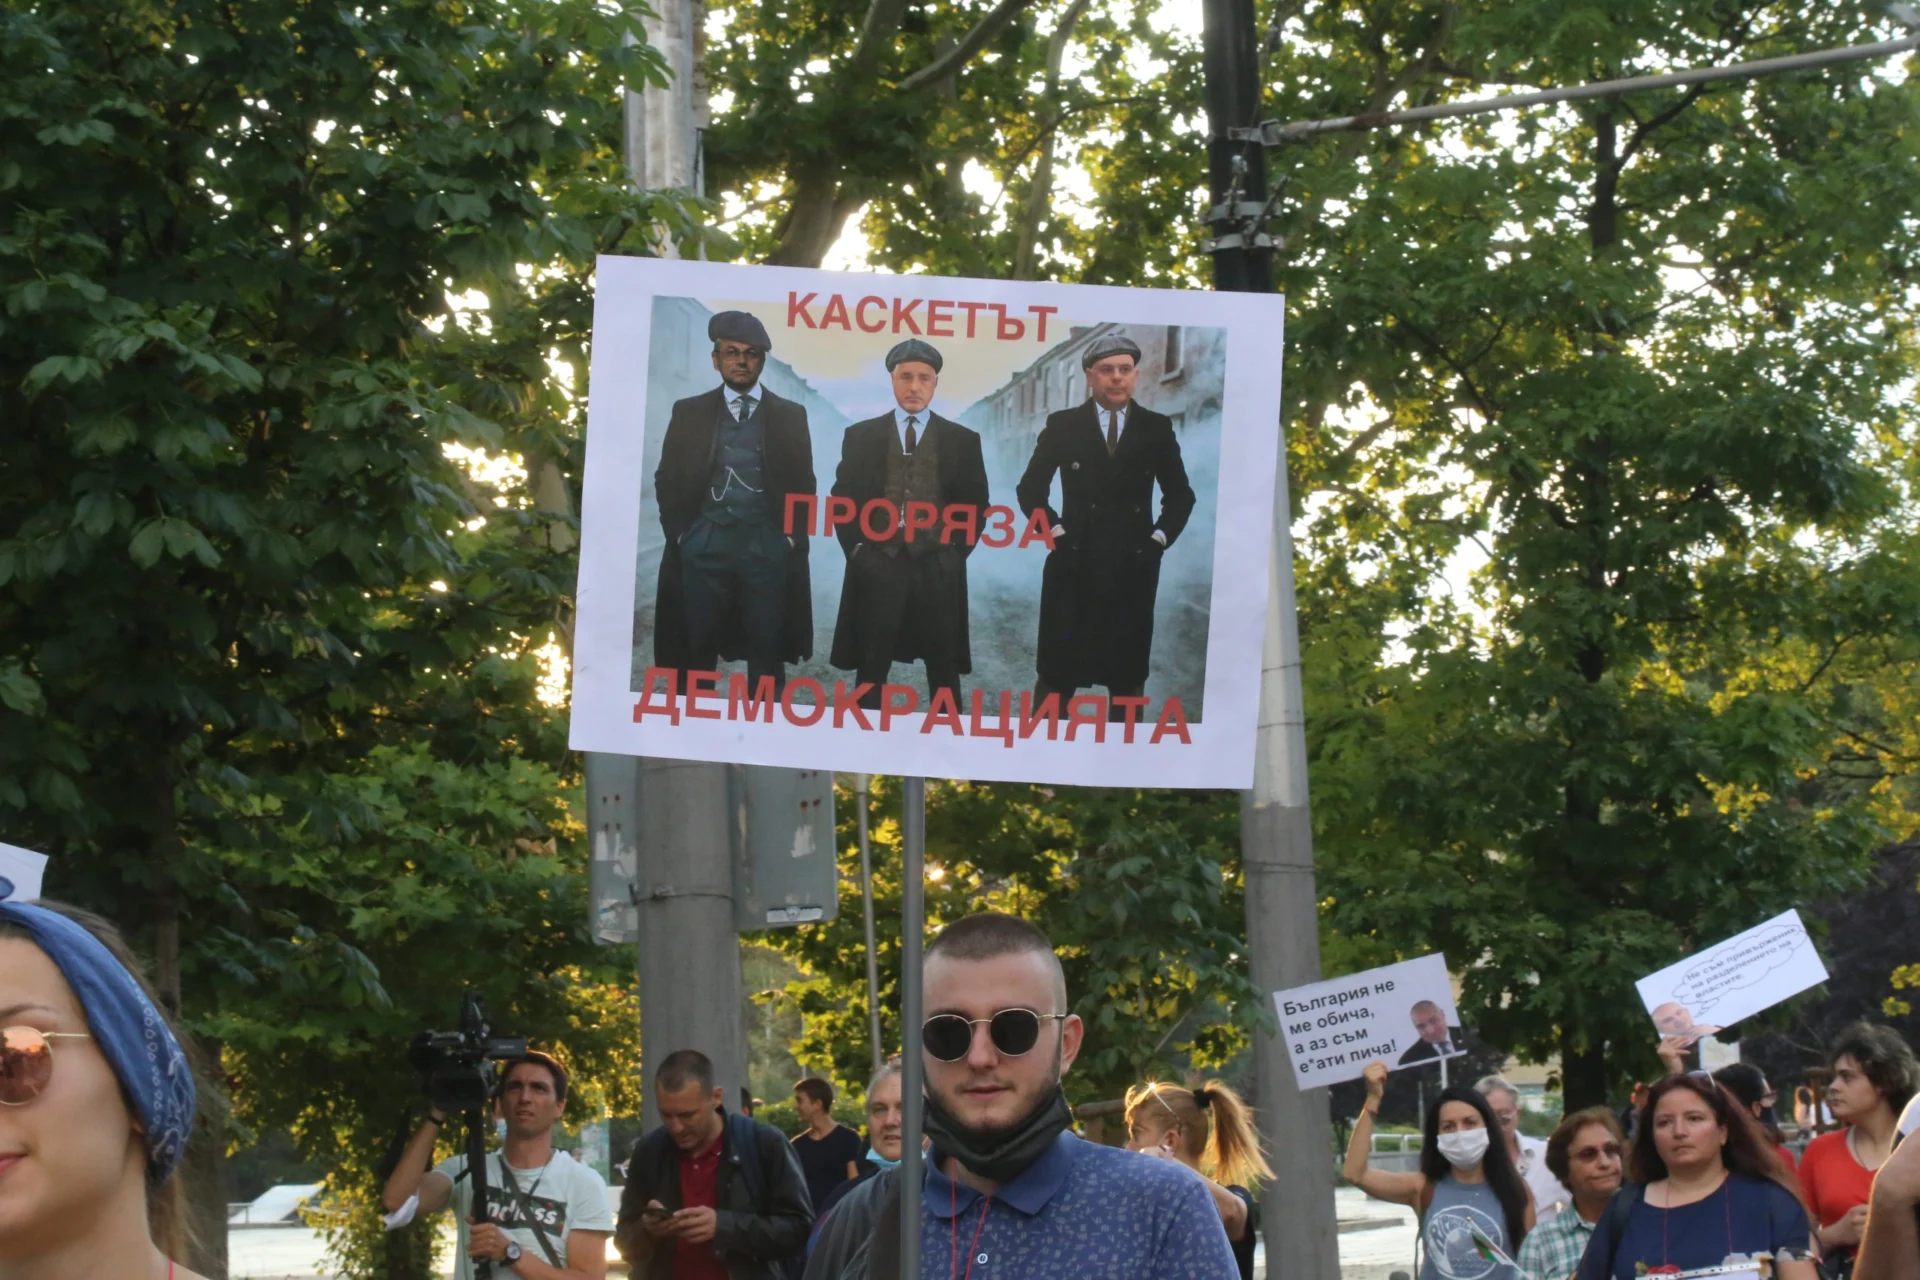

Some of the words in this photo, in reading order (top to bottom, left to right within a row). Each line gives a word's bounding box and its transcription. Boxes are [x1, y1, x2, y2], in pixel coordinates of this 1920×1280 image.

[788, 292, 1058, 343] КАСКЕТЪТ
[783, 492, 1057, 550] ПРОРЯЗА
[632, 667, 1192, 748] ДЕМОКРАЦИЯТА
[1686, 971, 1701, 981] Не
[1706, 948, 1777, 984] разделението
[1283, 986, 1370, 1016] България
[1375, 980, 1395, 995] не
[1289, 1020, 1312, 1036] ме
[1317, 1007, 1375, 1029] обича,
[1294, 1043, 1305, 1054] а
[1309, 1037, 1328, 1051] аз
[1332, 1028, 1368, 1045] съм
[1350, 1038, 1397, 1063] пича!
